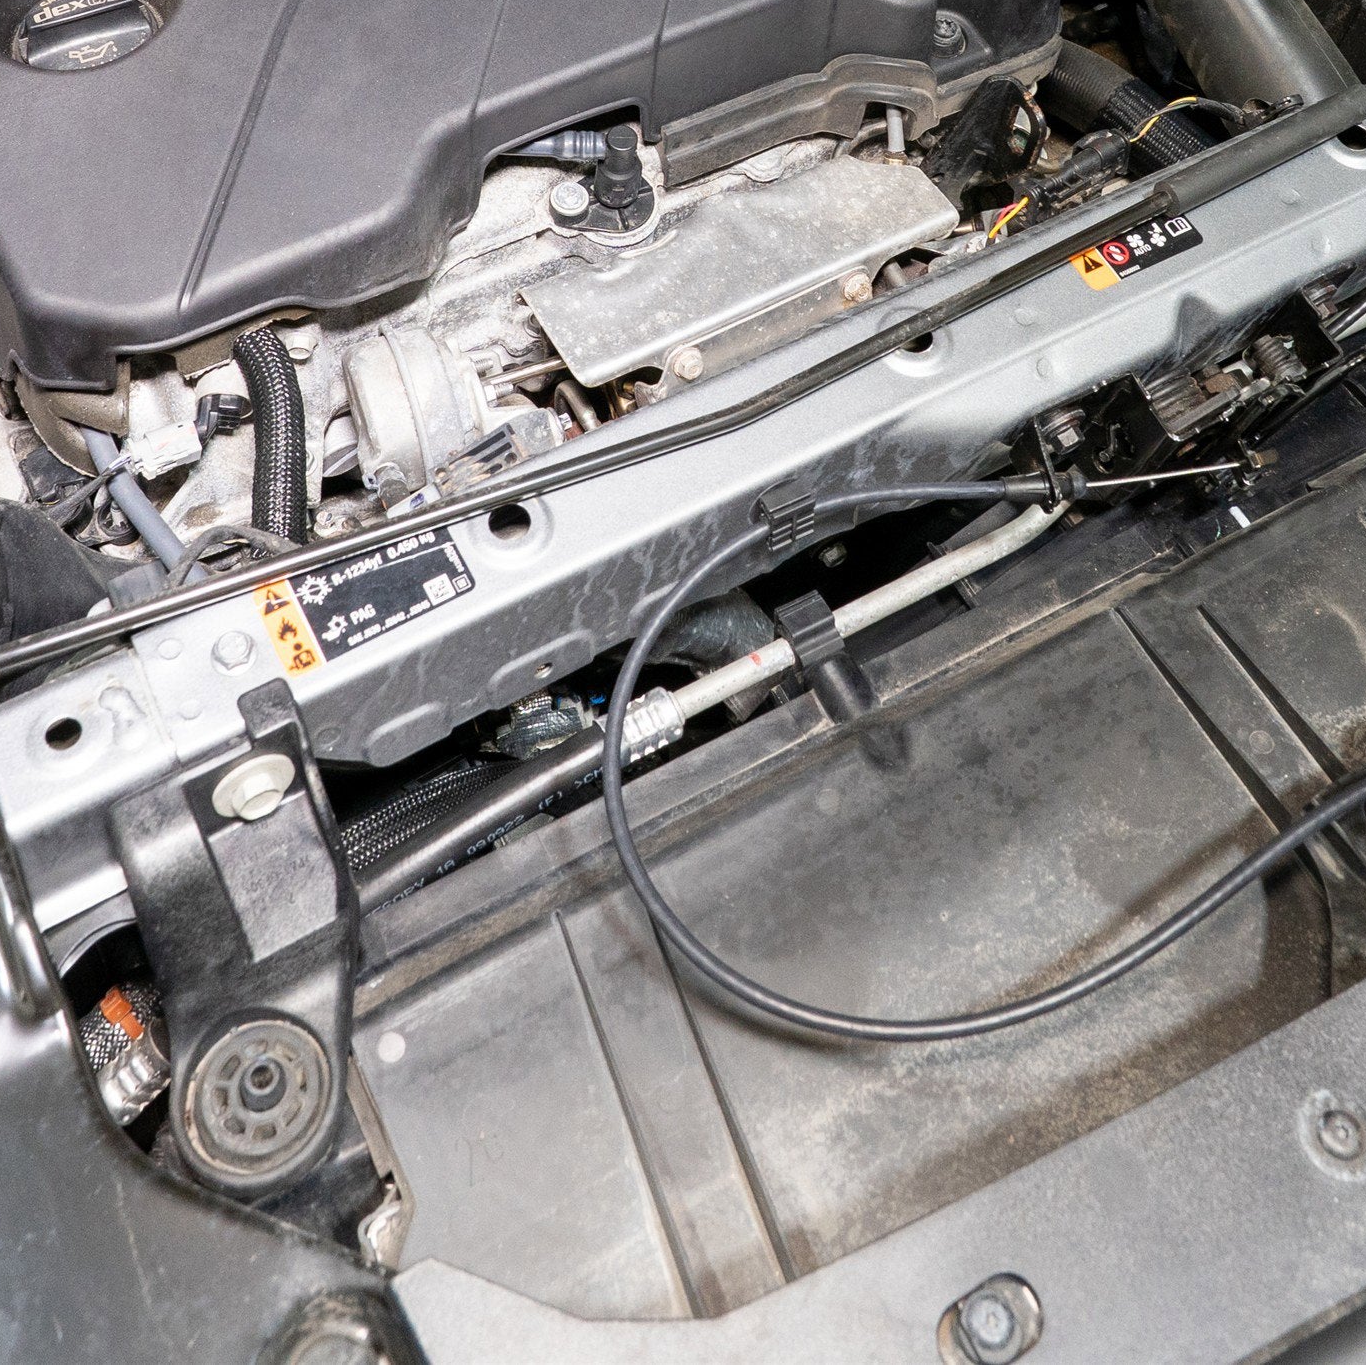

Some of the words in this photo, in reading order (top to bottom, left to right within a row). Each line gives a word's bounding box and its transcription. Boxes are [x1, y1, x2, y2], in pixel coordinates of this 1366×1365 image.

[1133, 243, 1152, 257] AUTO
[331, 552, 383, 587] R-1234yf
[386, 536, 420, 560] 0.450
[349, 604, 376, 625] PAG
[466, 814, 525, 856] 090922
